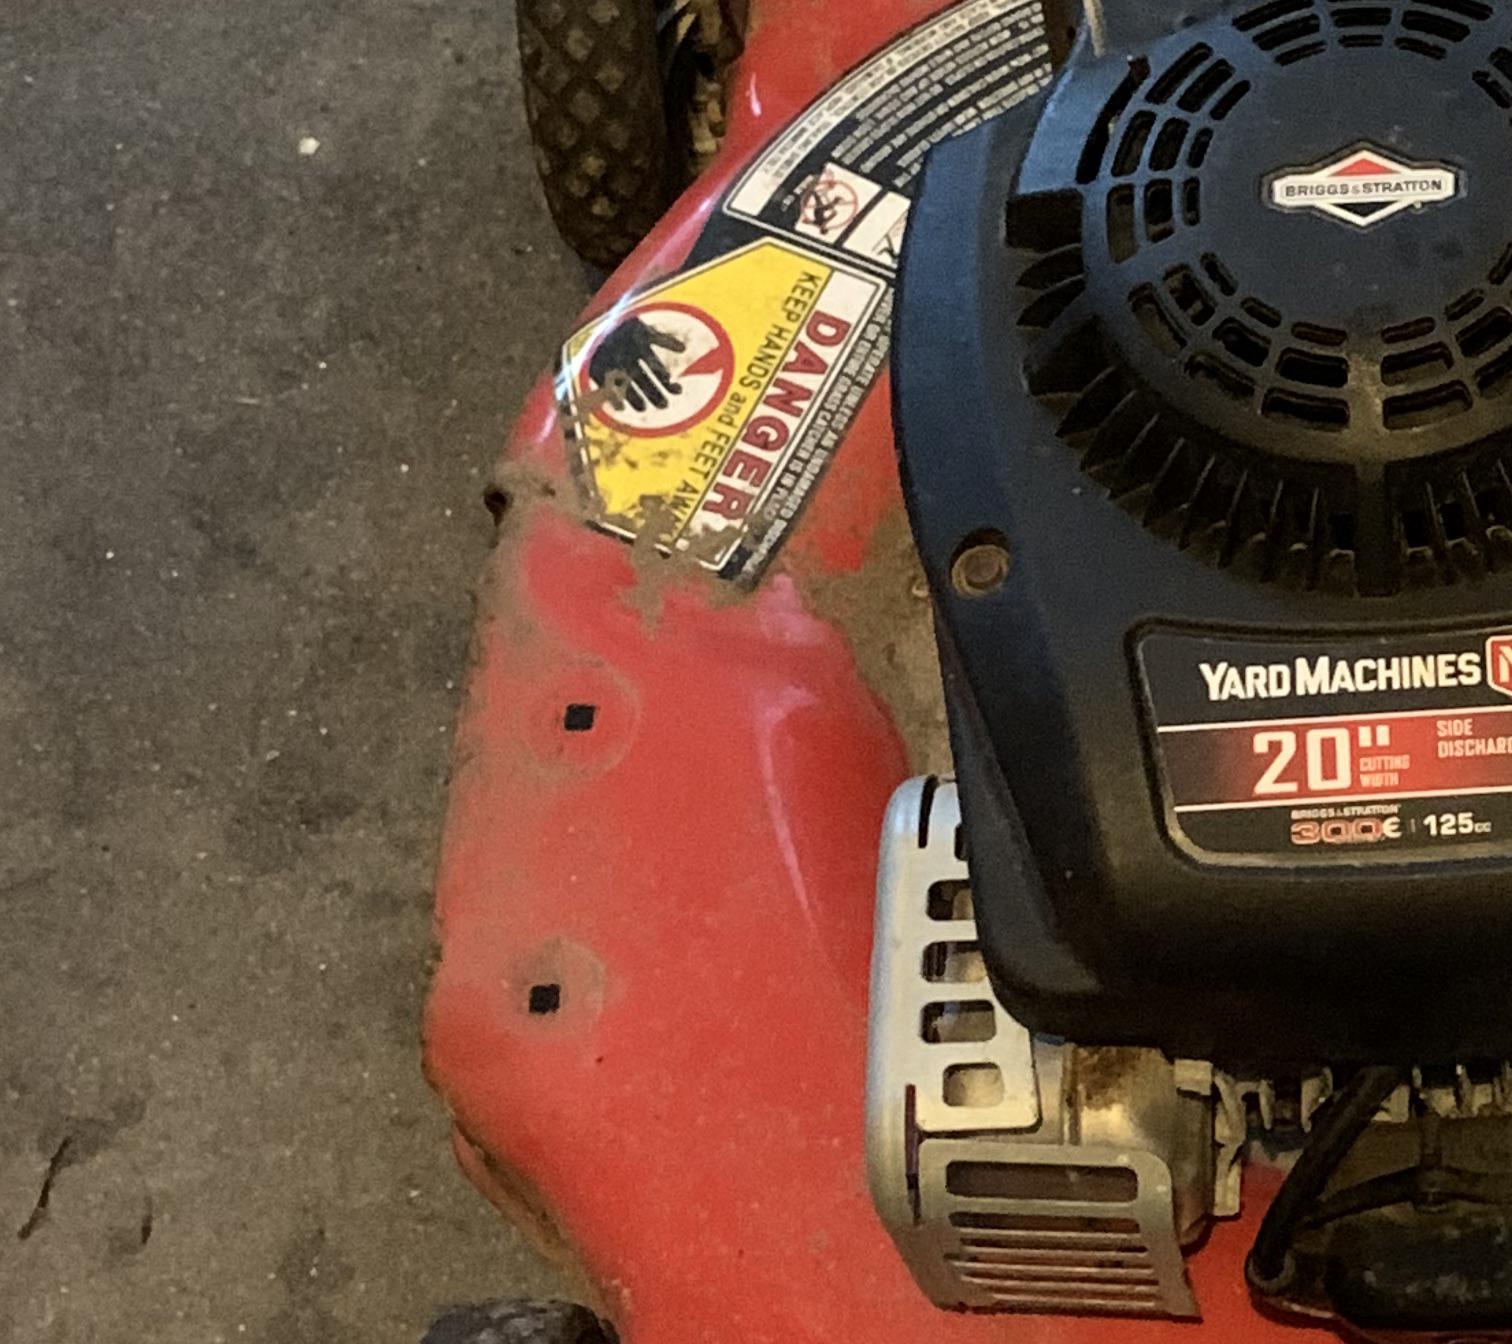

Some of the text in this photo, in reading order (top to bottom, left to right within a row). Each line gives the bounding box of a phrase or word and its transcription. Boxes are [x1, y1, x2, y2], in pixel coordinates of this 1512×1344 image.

[782, 271, 822, 323] KEEP
[740, 323, 792, 390] HANDS
[702, 309, 852, 521] DANGER
[717, 391, 747, 427] and
[689, 427, 731, 480] FEET
[1199, 661, 1292, 701] YARD
[1295, 652, 1482, 696] MACHINES
[1436, 718, 1474, 737] SIDE
[1252, 724, 1391, 796] 20"
[1359, 754, 1411, 773] CUTTING
[1360, 771, 1400, 788] WIDTH
